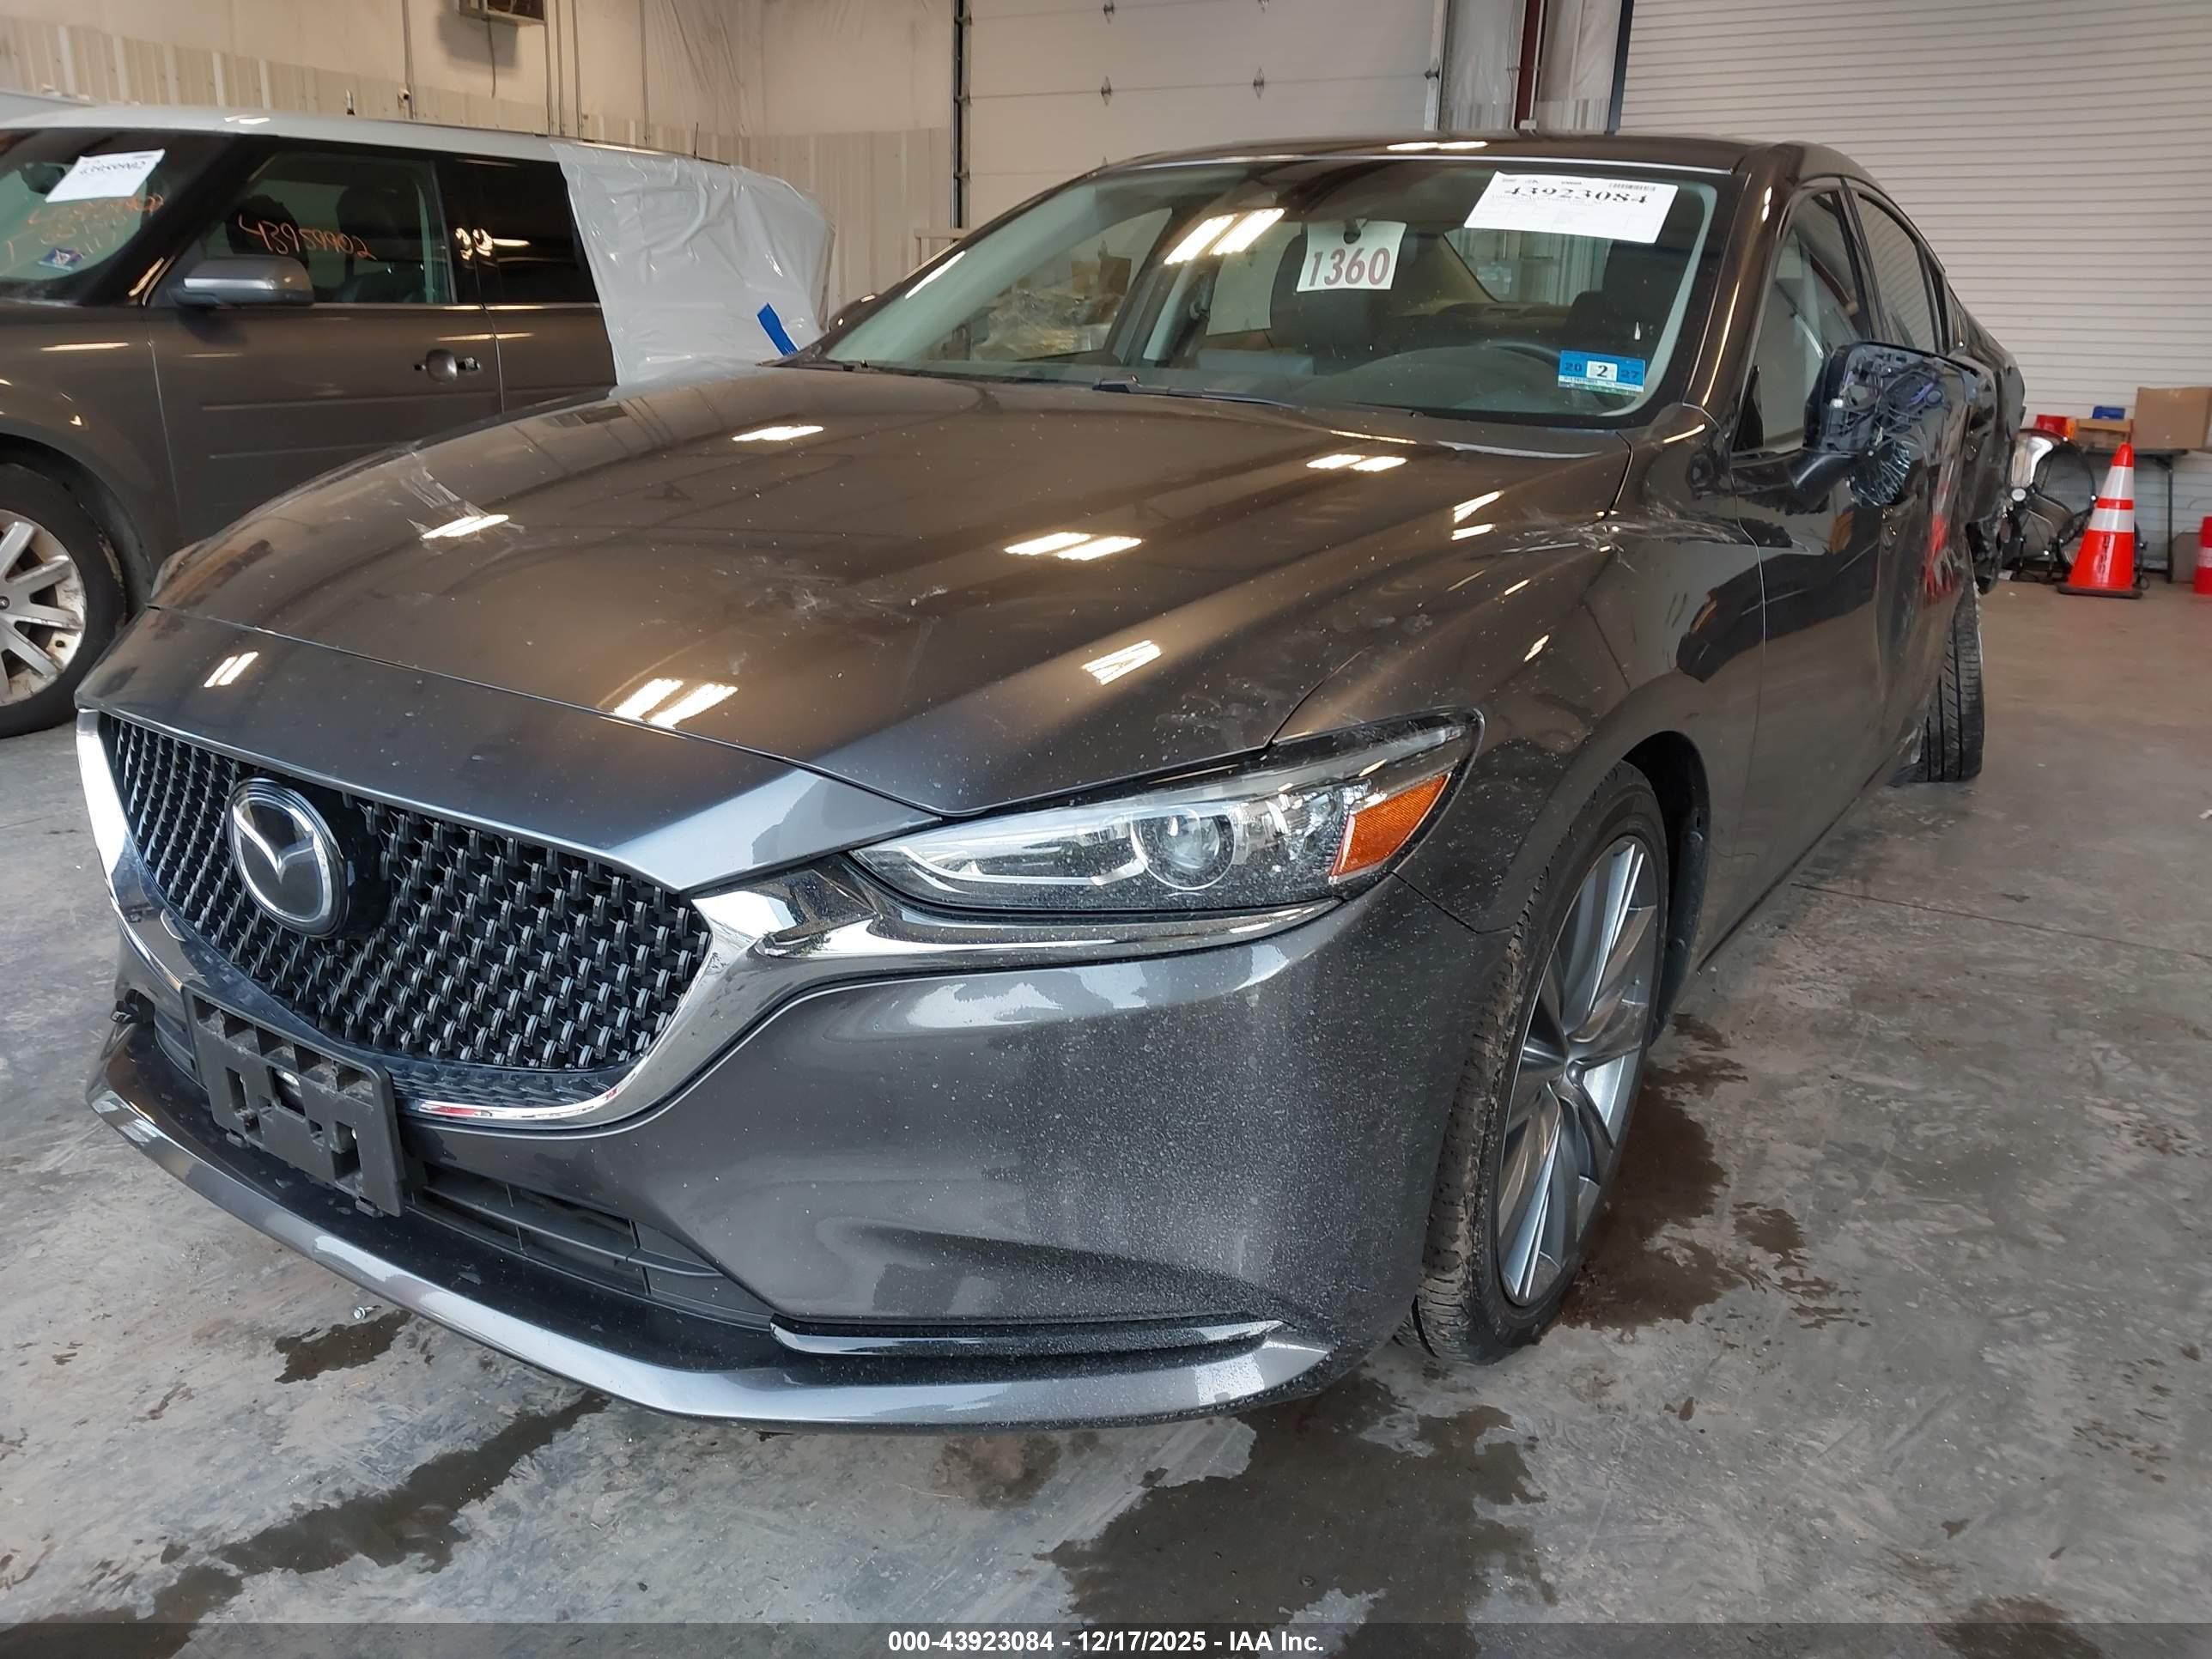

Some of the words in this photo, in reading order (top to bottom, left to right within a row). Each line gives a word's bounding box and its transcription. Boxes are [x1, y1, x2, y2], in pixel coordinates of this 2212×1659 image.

[1504, 185, 1649, 204] 43923084
[1309, 247, 1390, 287] 1360
[1596, 365, 1608, 378] 2
